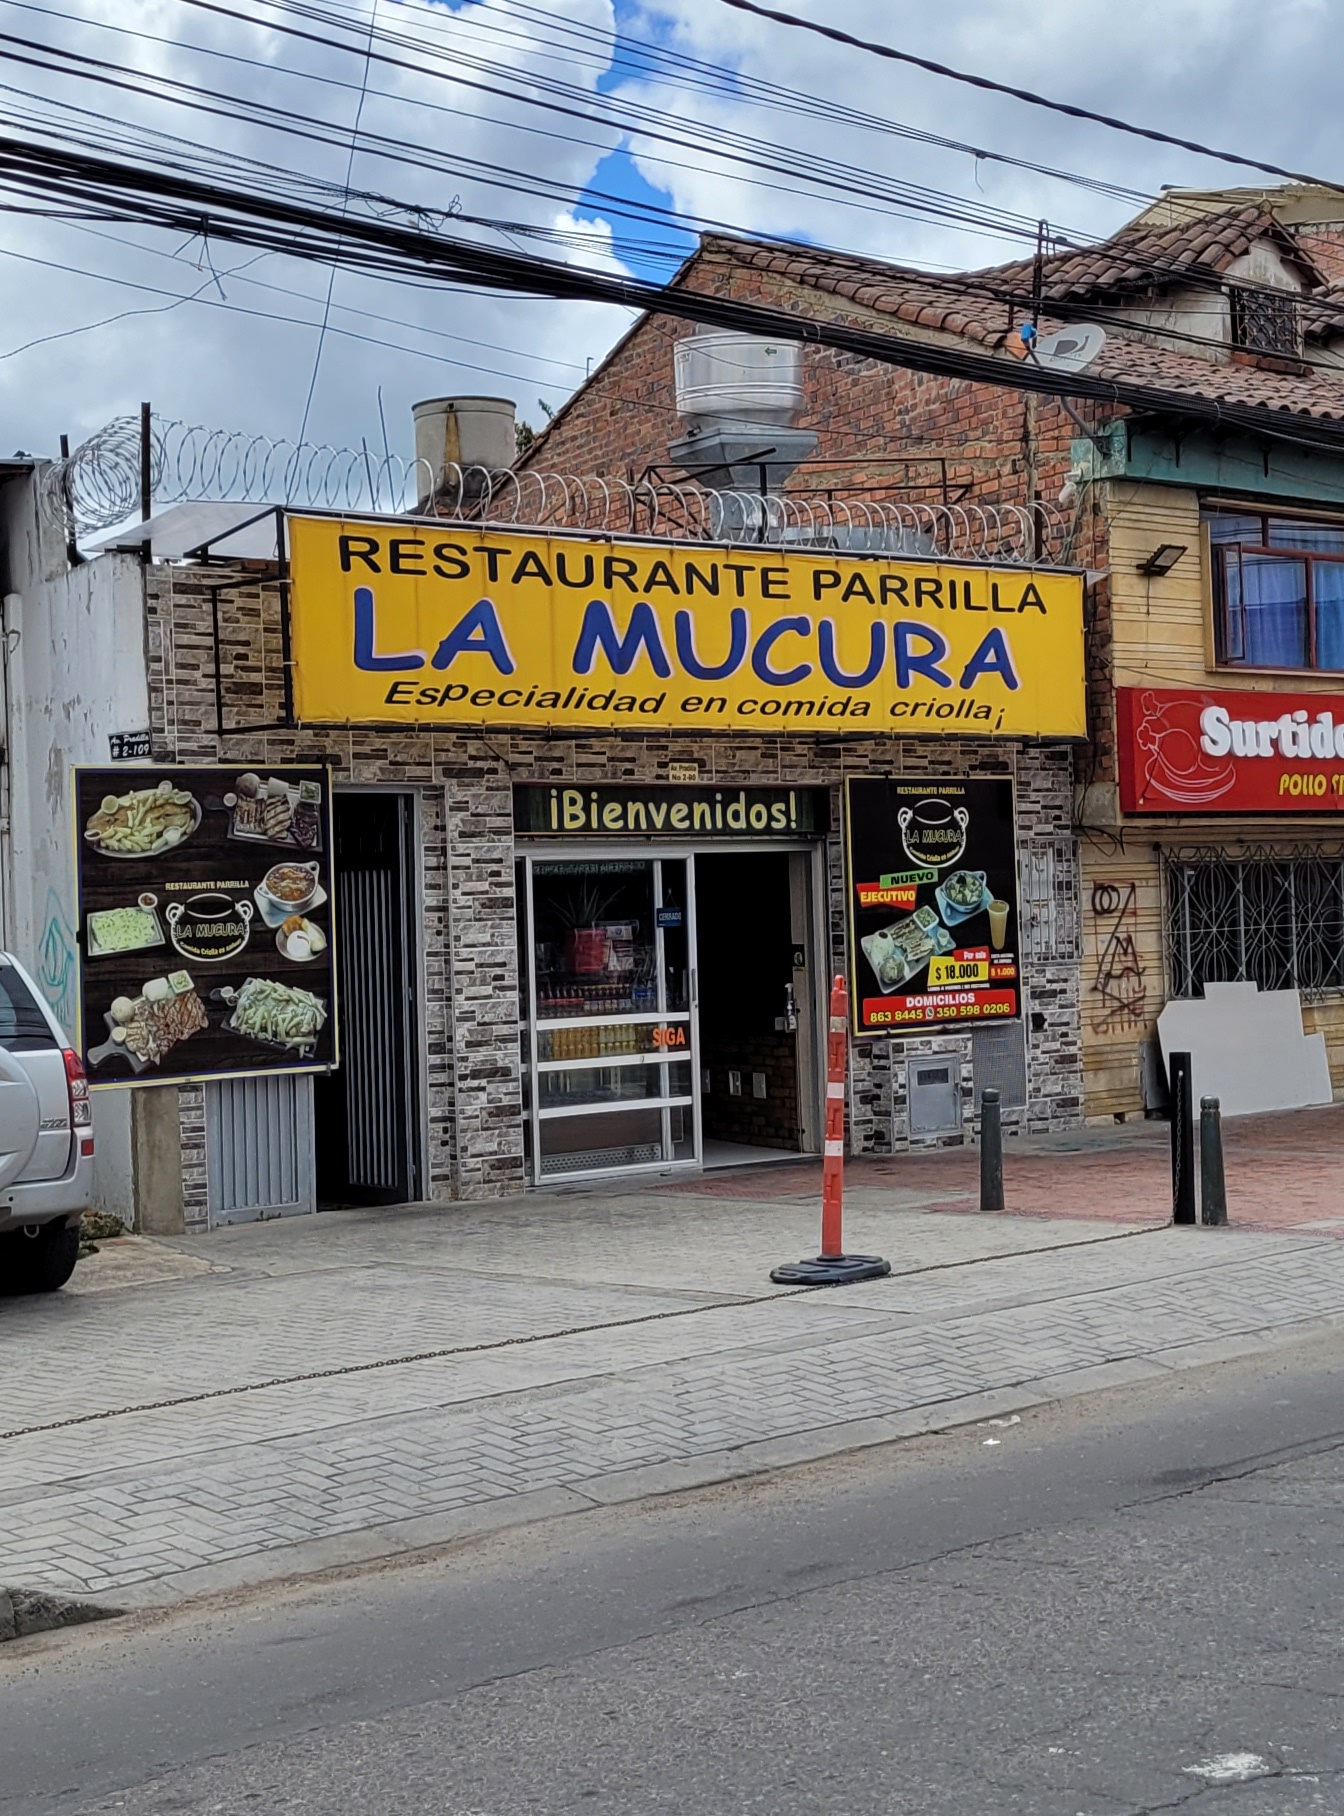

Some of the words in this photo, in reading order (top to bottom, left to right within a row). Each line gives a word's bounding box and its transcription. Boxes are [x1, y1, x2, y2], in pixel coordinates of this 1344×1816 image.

[338, 535, 792, 600] RESTAURANTE
[812, 569, 1048, 615] PARRILLA
[353, 586, 516, 675] LA
[571, 599, 1021, 691] MUCURA
[383, 680, 667, 714] Especialidad
[680, 695, 728, 713] en
[736, 695, 871, 718] comida
[122, 743, 149, 757] 2-109
[1279, 773, 1327, 796] POLLO
[550, 788, 797, 829] ¡Bienvenidos!
[165, 882, 215, 891] RESTAURANTE
[890, 871, 934, 886] NUEVO
[860, 890, 916, 903] EJECUTIVO
[176, 924, 193, 939] LA
[196, 922, 244, 938] MUCURA
[935, 966, 942, 981] $
[944, 963, 979, 979] 18.000
[906, 993, 975, 1008] DOMICILIOS
[870, 1011, 892, 1023] 863
[894, 1009, 923, 1021] 8445
[936, 1006, 957, 1018] 350
[959, 1005, 981, 1016] 598
[983, 1003, 1010, 1014] 0206
[652, 1027, 686, 1047] SIGA
